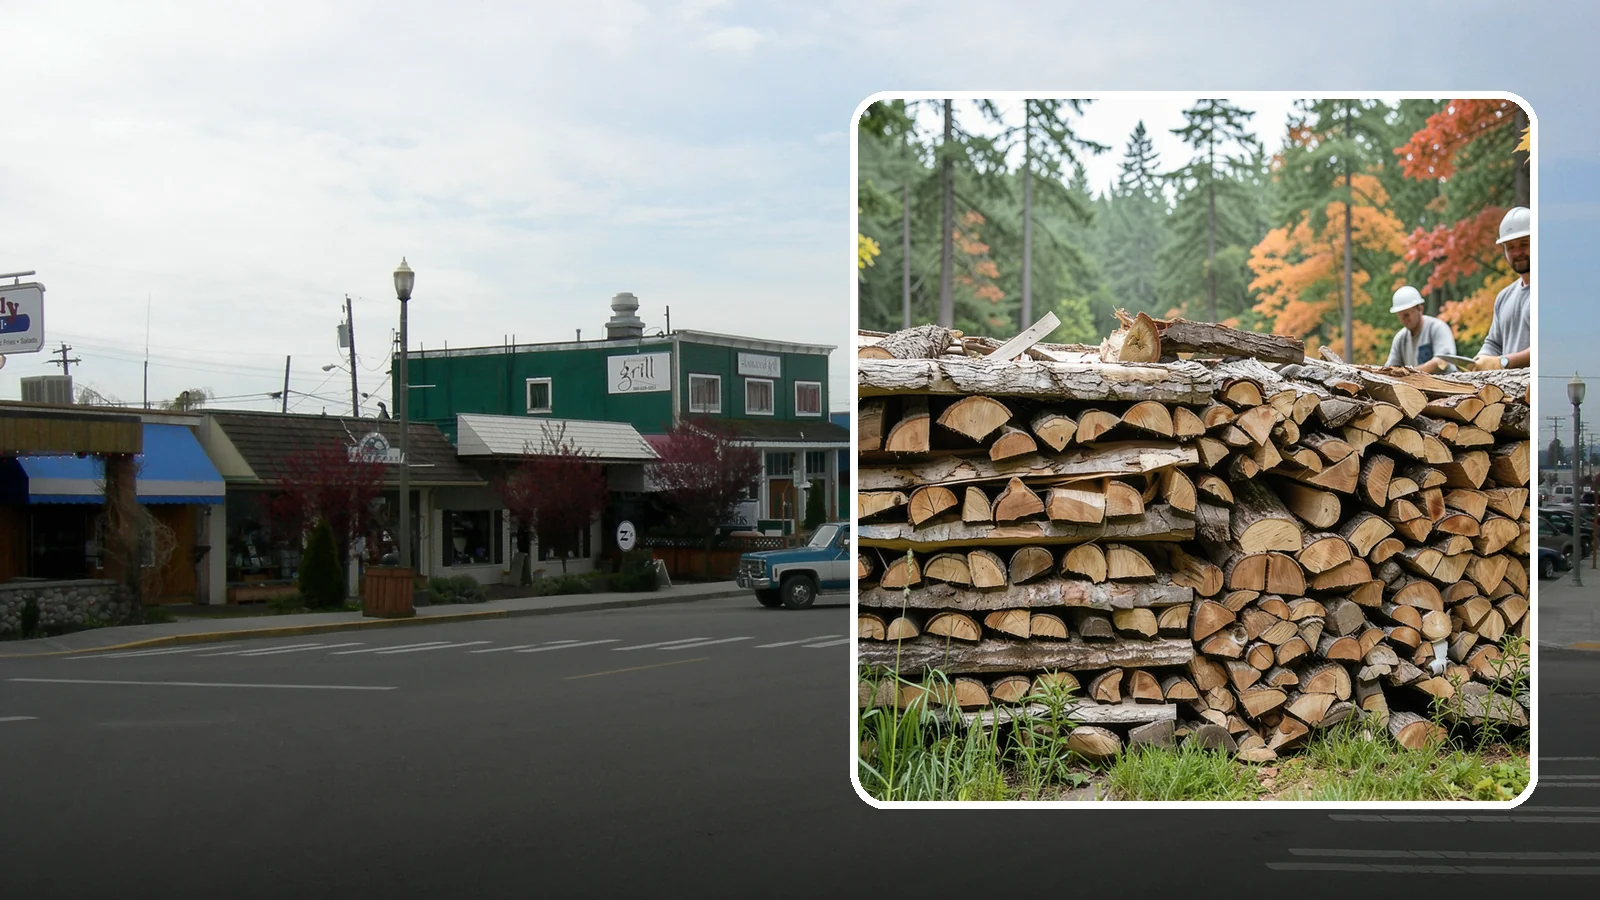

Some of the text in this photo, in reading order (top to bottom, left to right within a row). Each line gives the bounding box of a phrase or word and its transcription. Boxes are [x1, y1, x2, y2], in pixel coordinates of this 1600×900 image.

[3, 337, 38, 346] Fries Salads
[617, 355, 654, 391] grill
